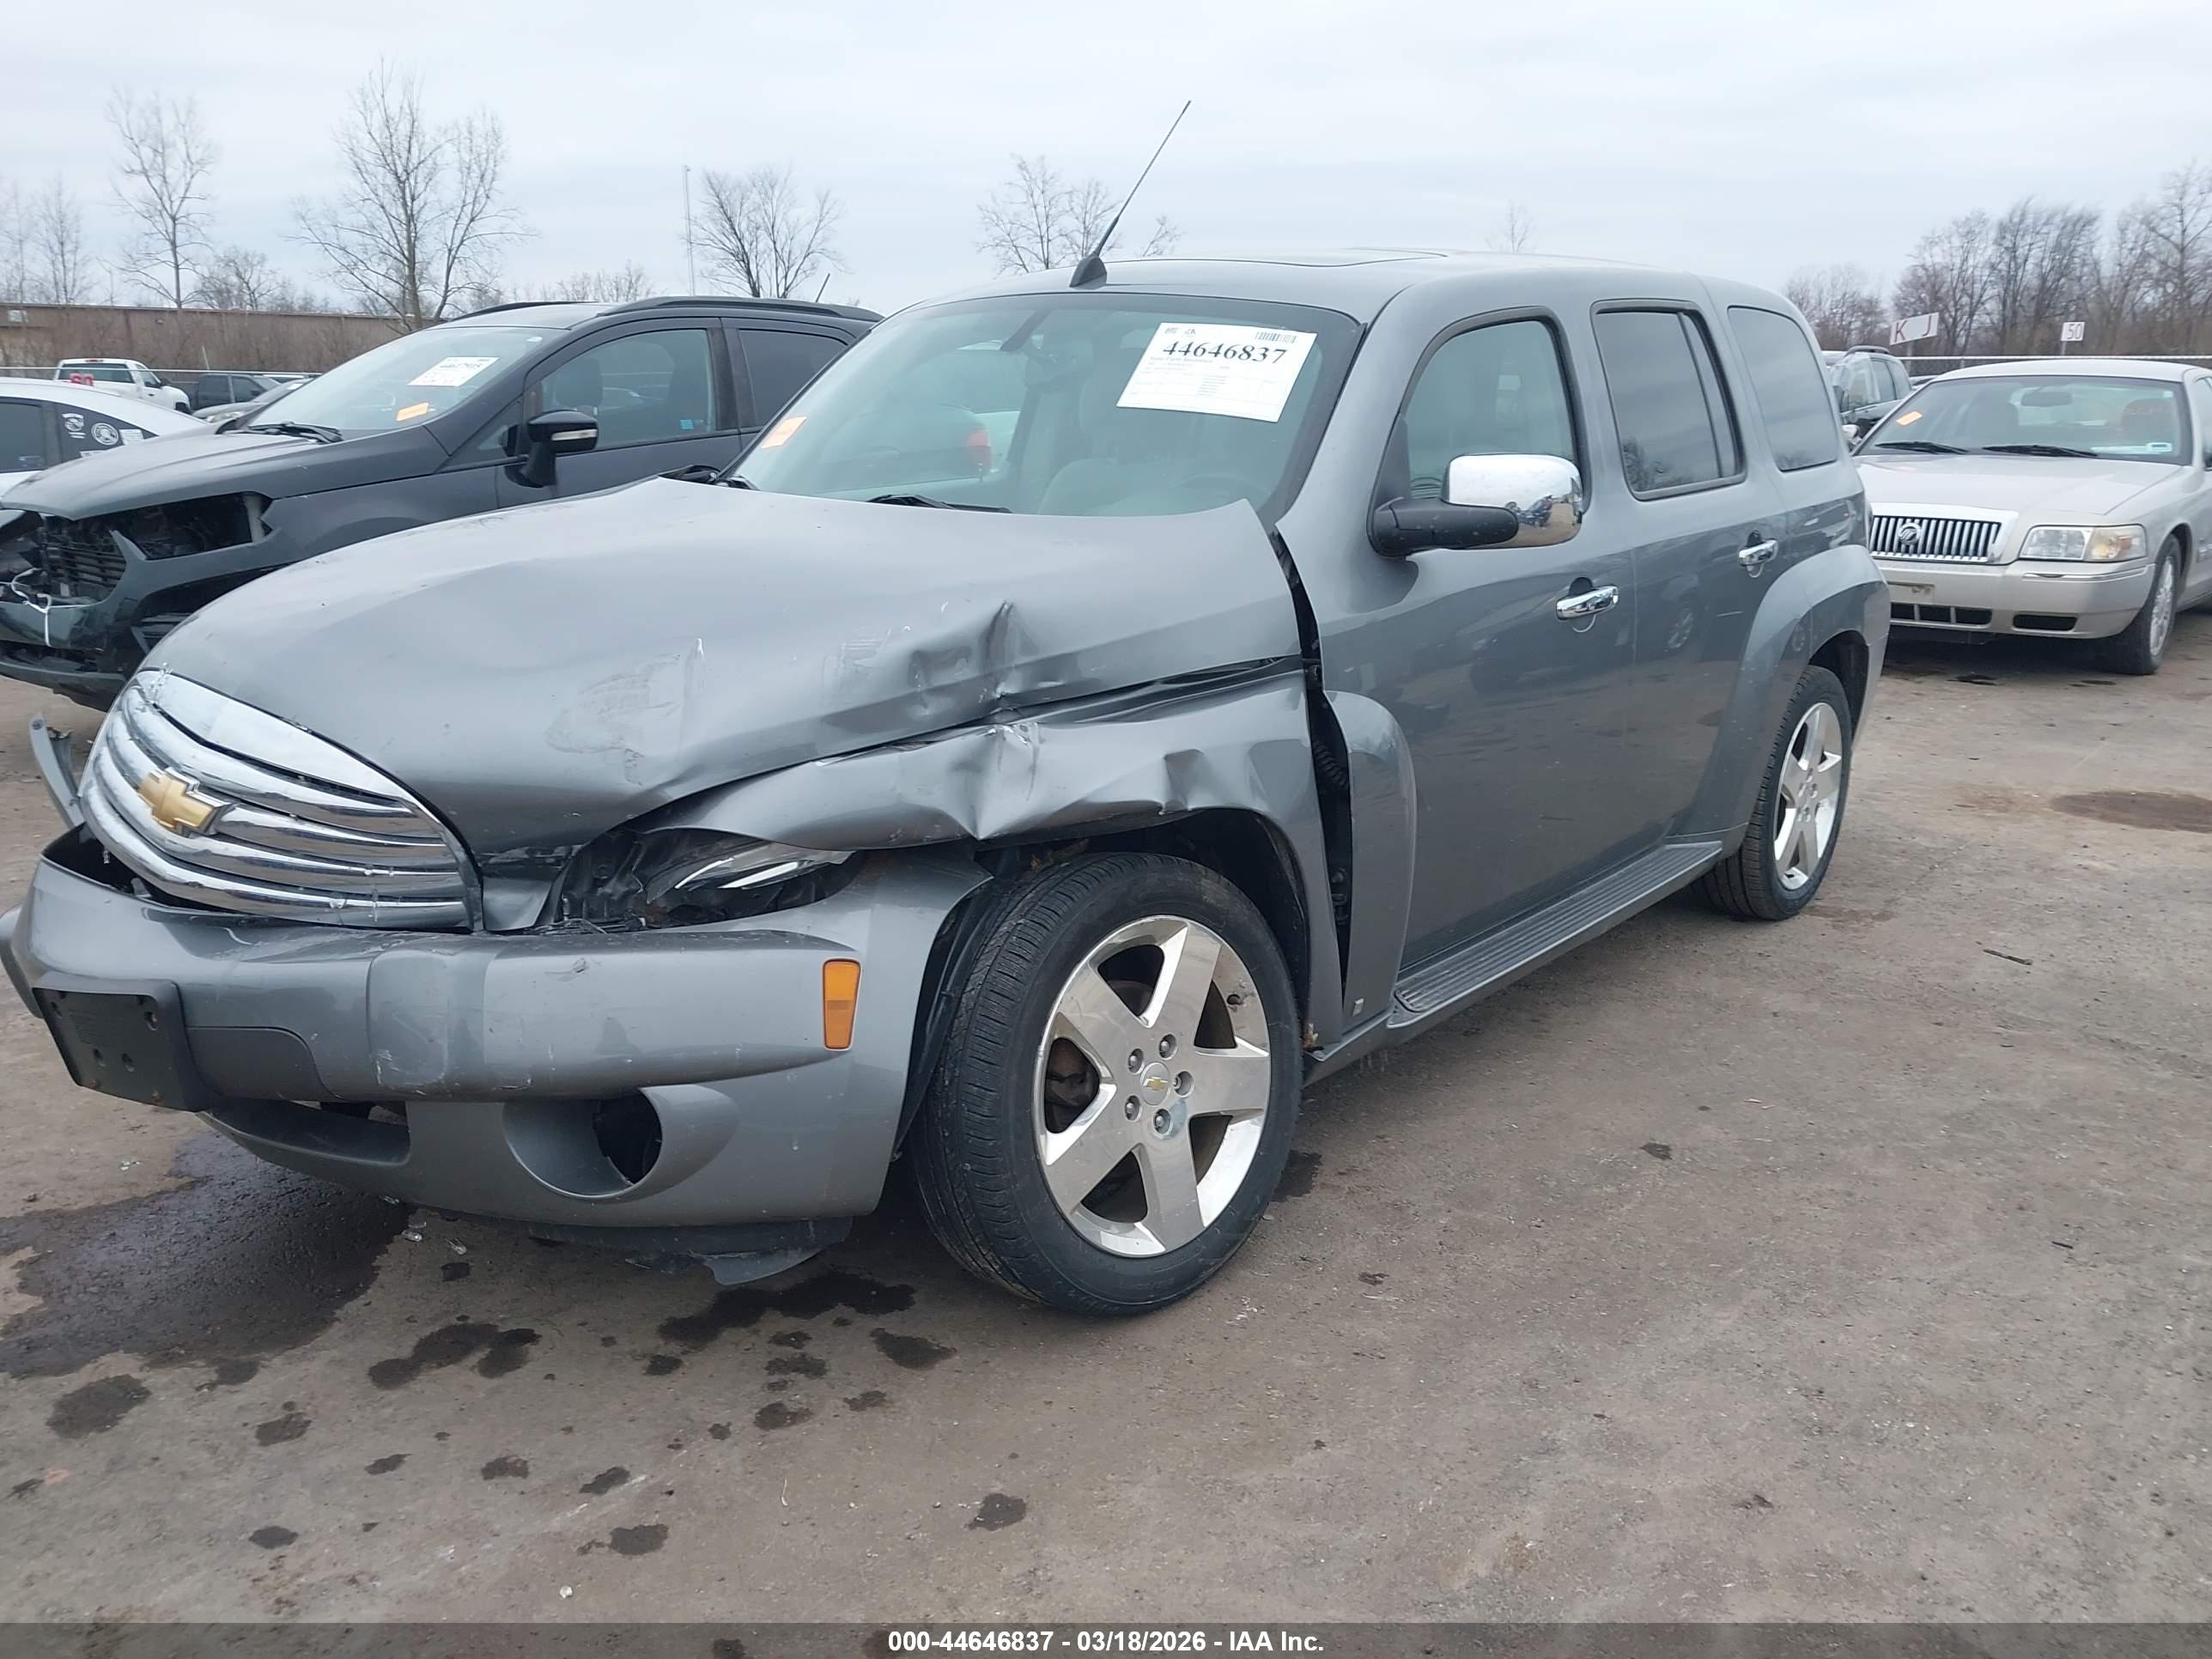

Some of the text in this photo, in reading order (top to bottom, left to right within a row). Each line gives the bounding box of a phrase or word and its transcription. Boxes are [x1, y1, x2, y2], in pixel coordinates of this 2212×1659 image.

[1894, 315, 1932, 343] K J
[2066, 324, 2082, 340] 50
[1162, 341, 1287, 363] 44646837
